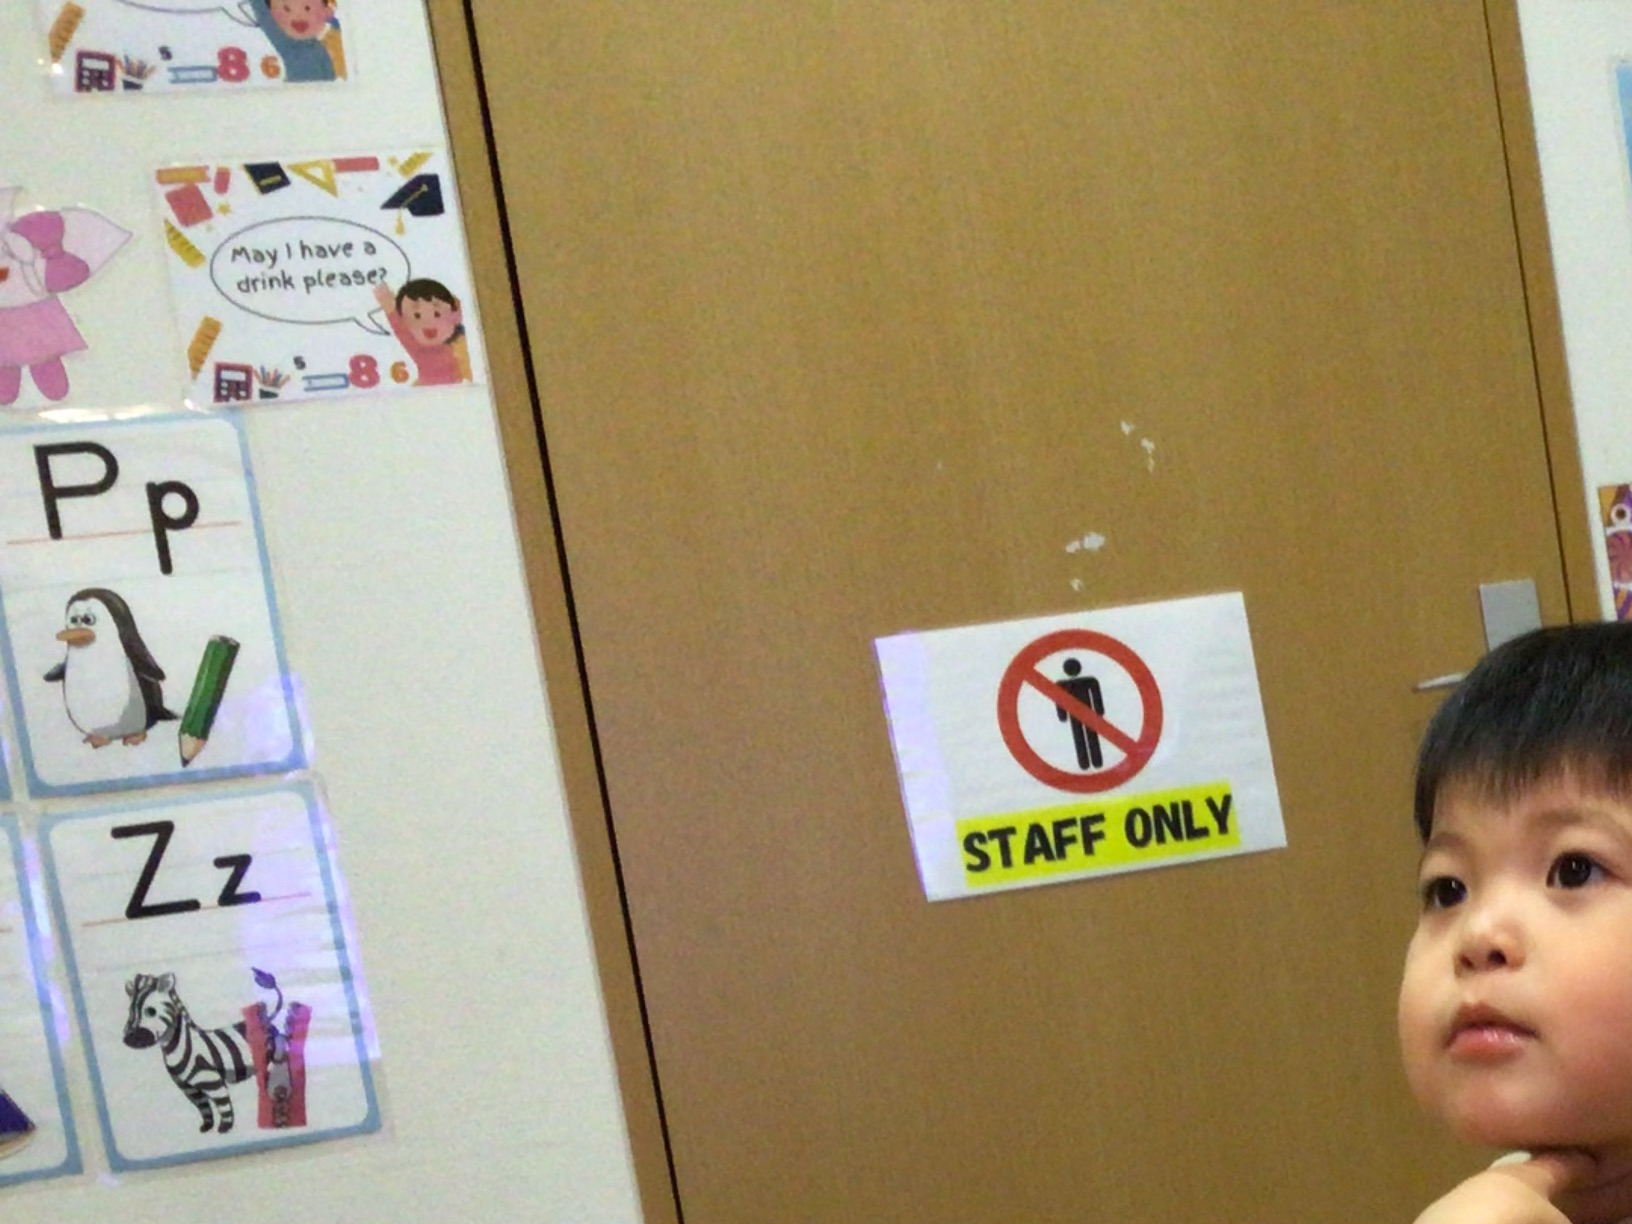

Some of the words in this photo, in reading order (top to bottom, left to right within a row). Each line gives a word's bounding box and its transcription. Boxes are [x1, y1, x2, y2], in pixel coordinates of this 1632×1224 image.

[217, 46, 250, 82] 8
[231, 246, 278, 269] May
[285, 242, 292, 260] I
[299, 239, 354, 260] have
[363, 241, 377, 256] a
[236, 269, 296, 294] drink
[303, 267, 388, 295] please?
[348, 354, 380, 388] 8
[962, 813, 1107, 873] STAFF
[1124, 794, 1233, 849] ONLY
